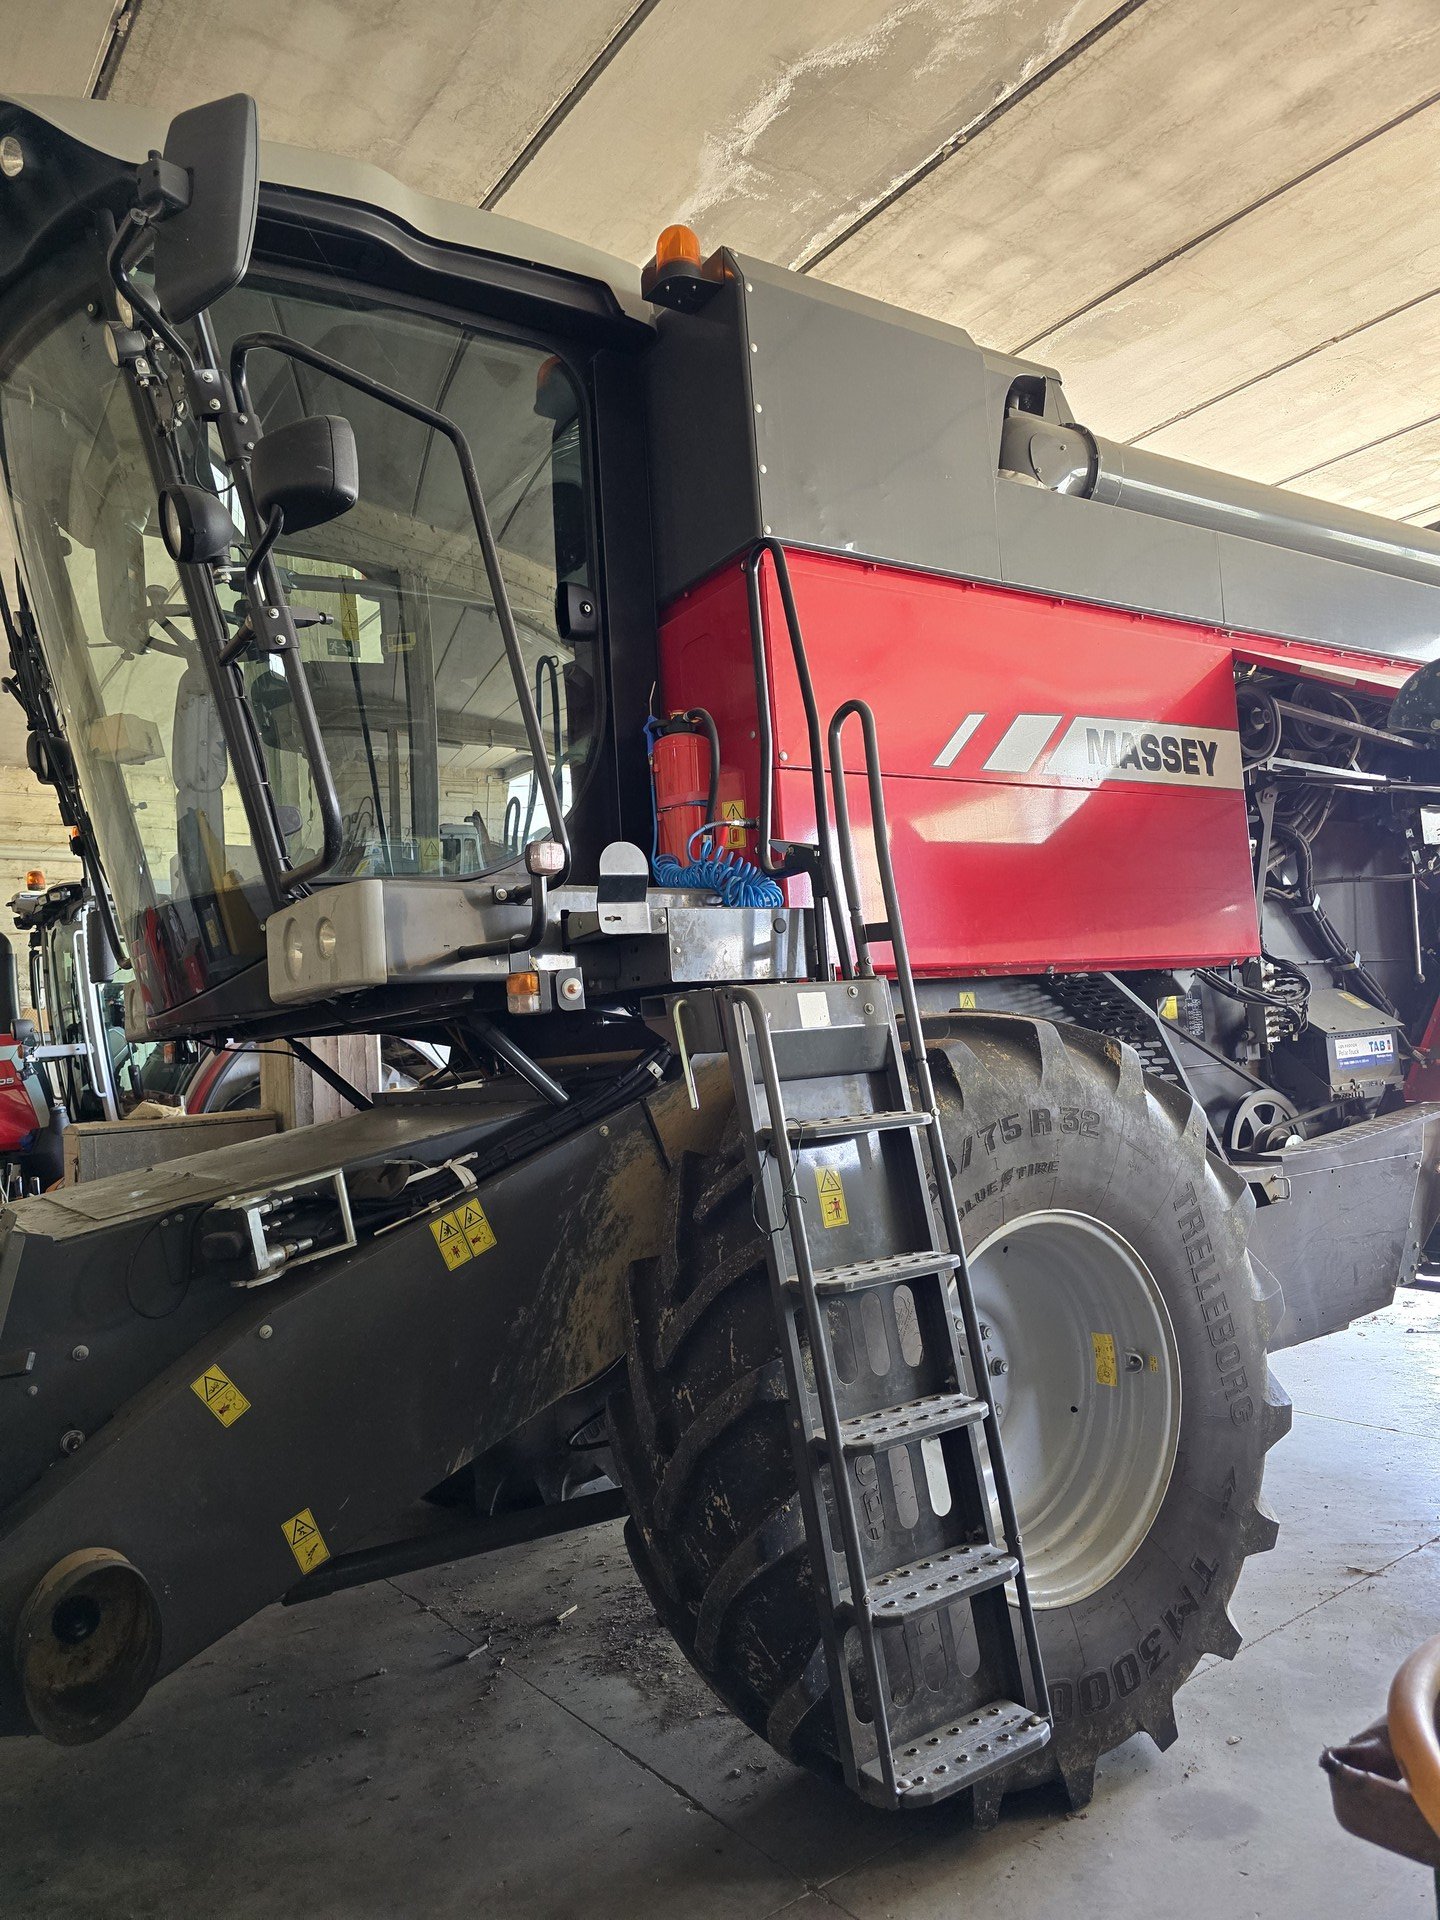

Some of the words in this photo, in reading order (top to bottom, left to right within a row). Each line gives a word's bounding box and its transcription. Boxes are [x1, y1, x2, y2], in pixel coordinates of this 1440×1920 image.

[1085, 727, 1218, 777] MASSEY
[1368, 1040, 1386, 1053] TAB
[1030, 1108, 1052, 1137] R
[1059, 1106, 1101, 1138] 32
[1015, 1160, 1060, 1180] TIRE
[1173, 1181, 1254, 1427] TRELLEBORG
[1048, 1552, 1221, 1724] TM3000
